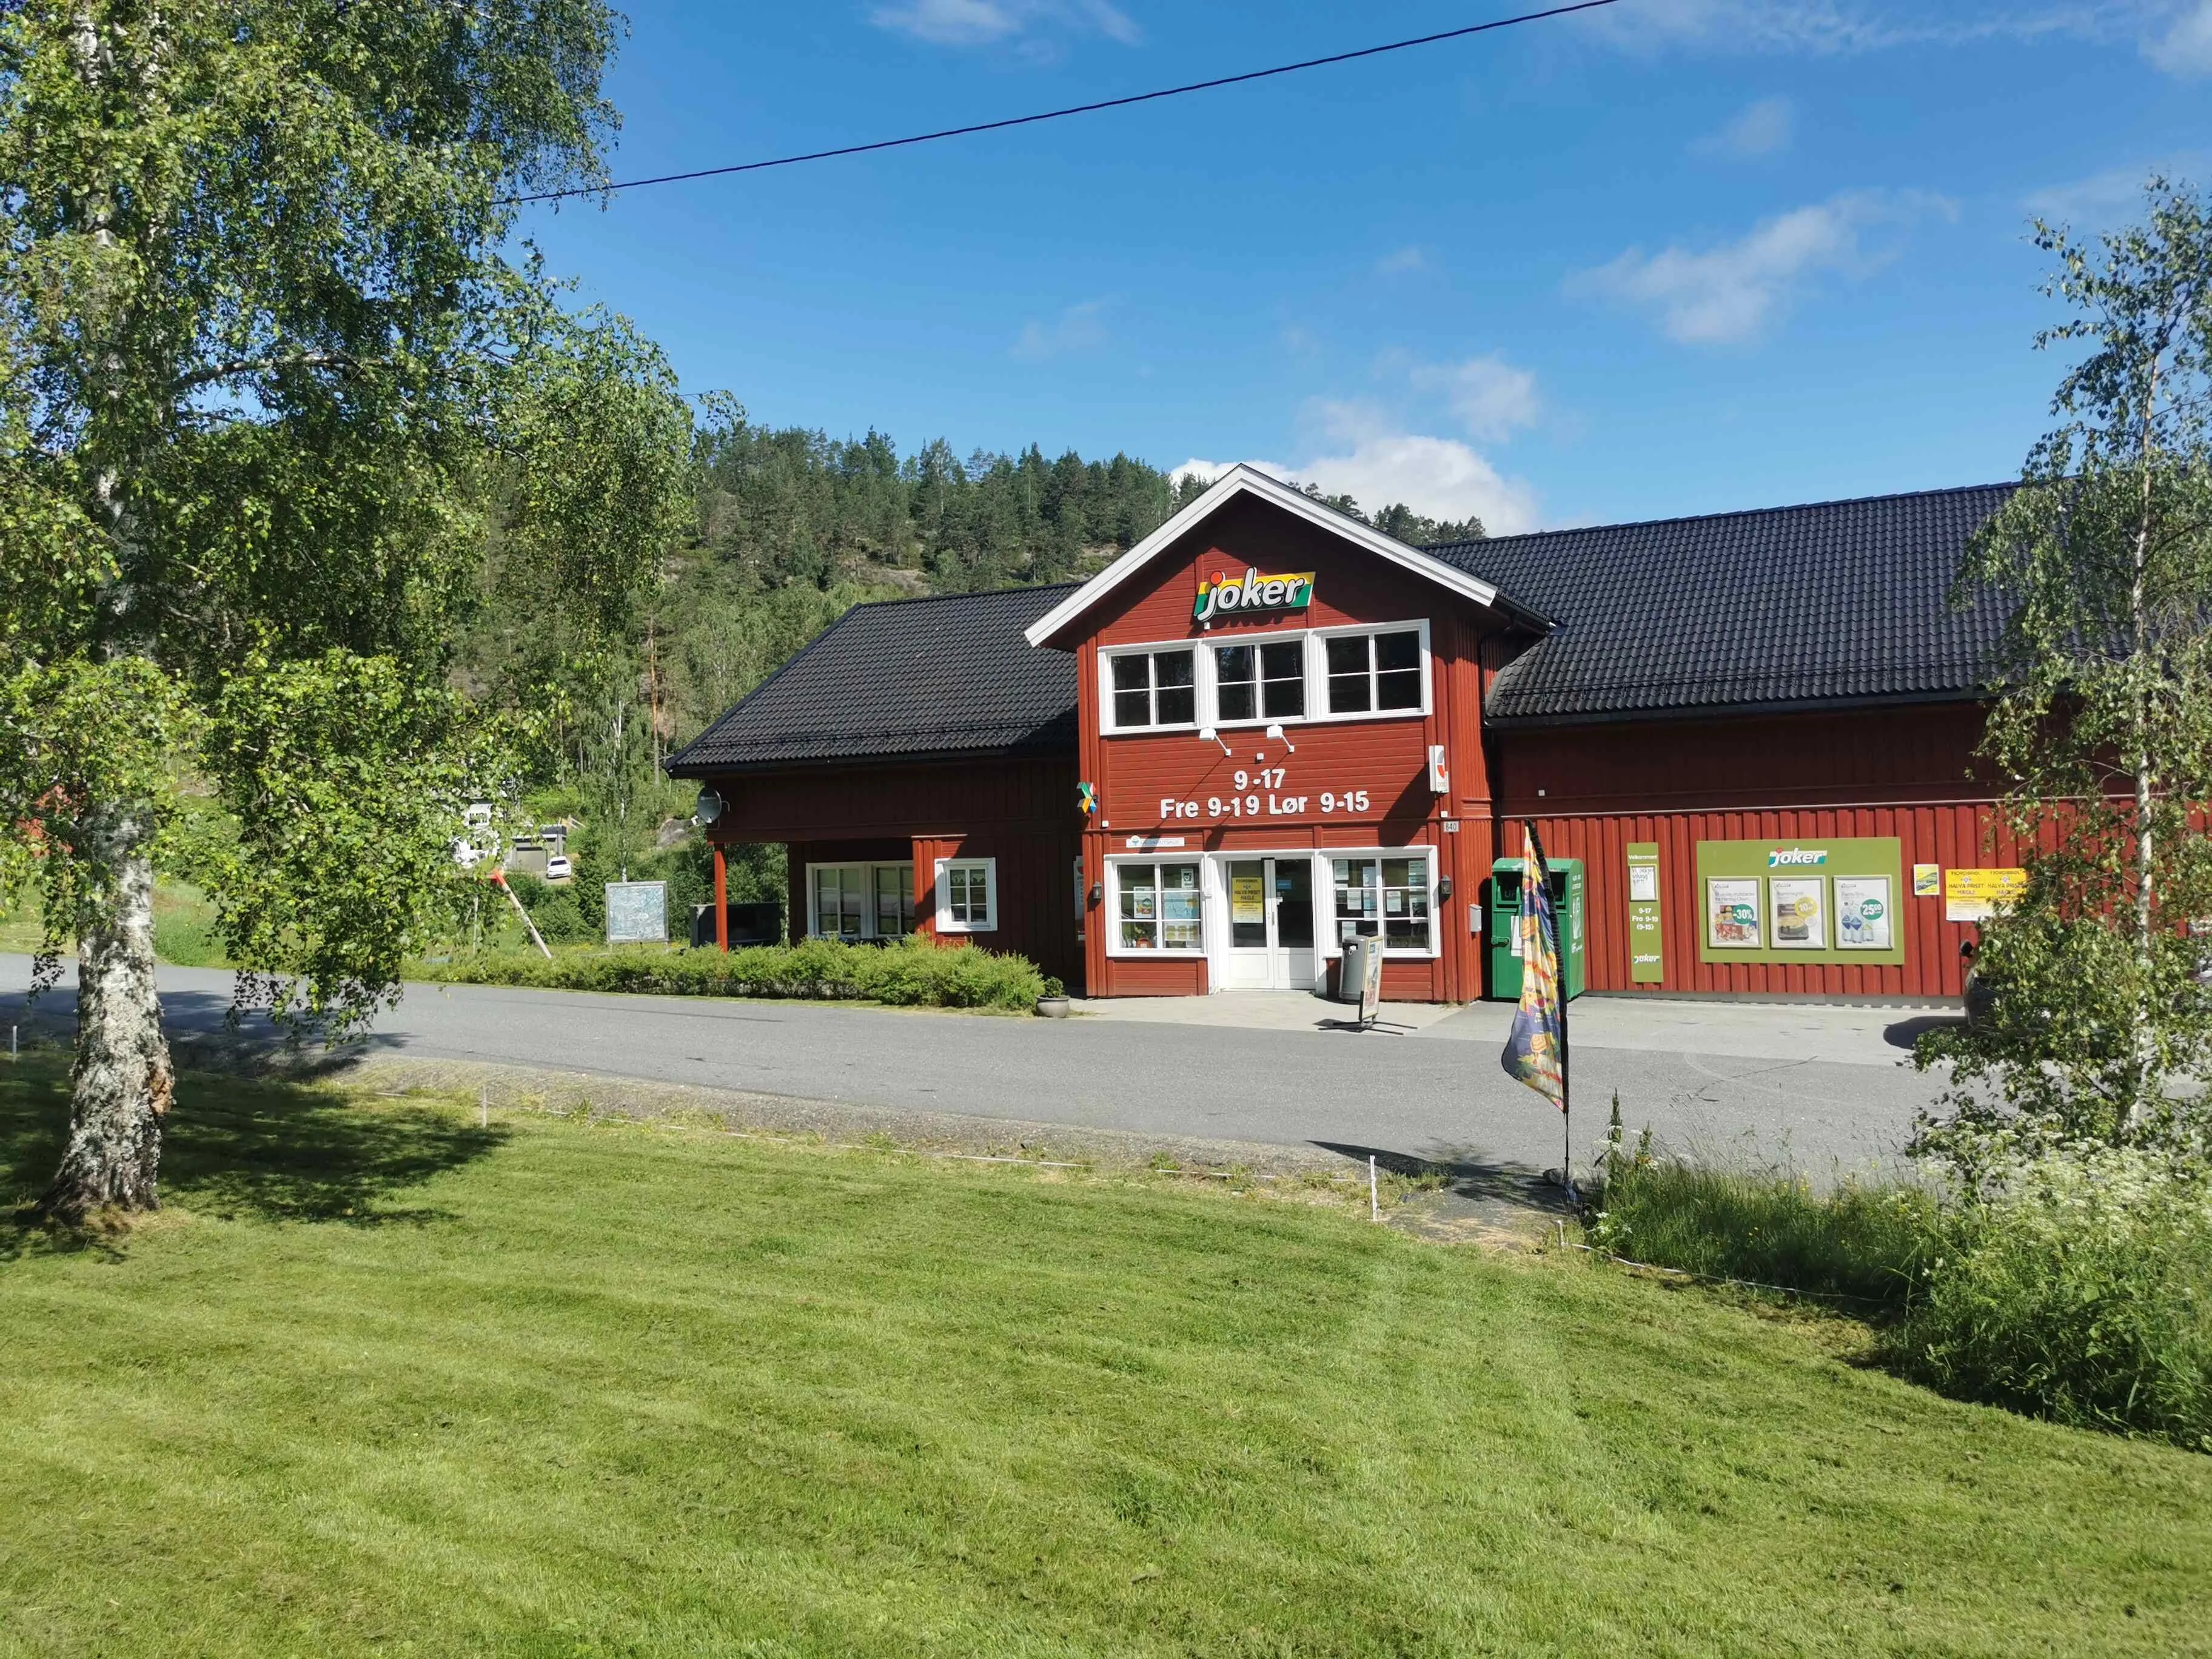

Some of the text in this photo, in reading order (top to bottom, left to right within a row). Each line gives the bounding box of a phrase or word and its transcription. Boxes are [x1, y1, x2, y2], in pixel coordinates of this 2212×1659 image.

[1197, 566, 1305, 621] joker
[1234, 768, 1286, 791] 9-17
[1161, 791, 1370, 819] Fre 9-19 Lør 9-15
[1769, 847, 1823, 868] joker
[1732, 909, 1753, 920] -30%
[1634, 953, 1659, 964] joker
